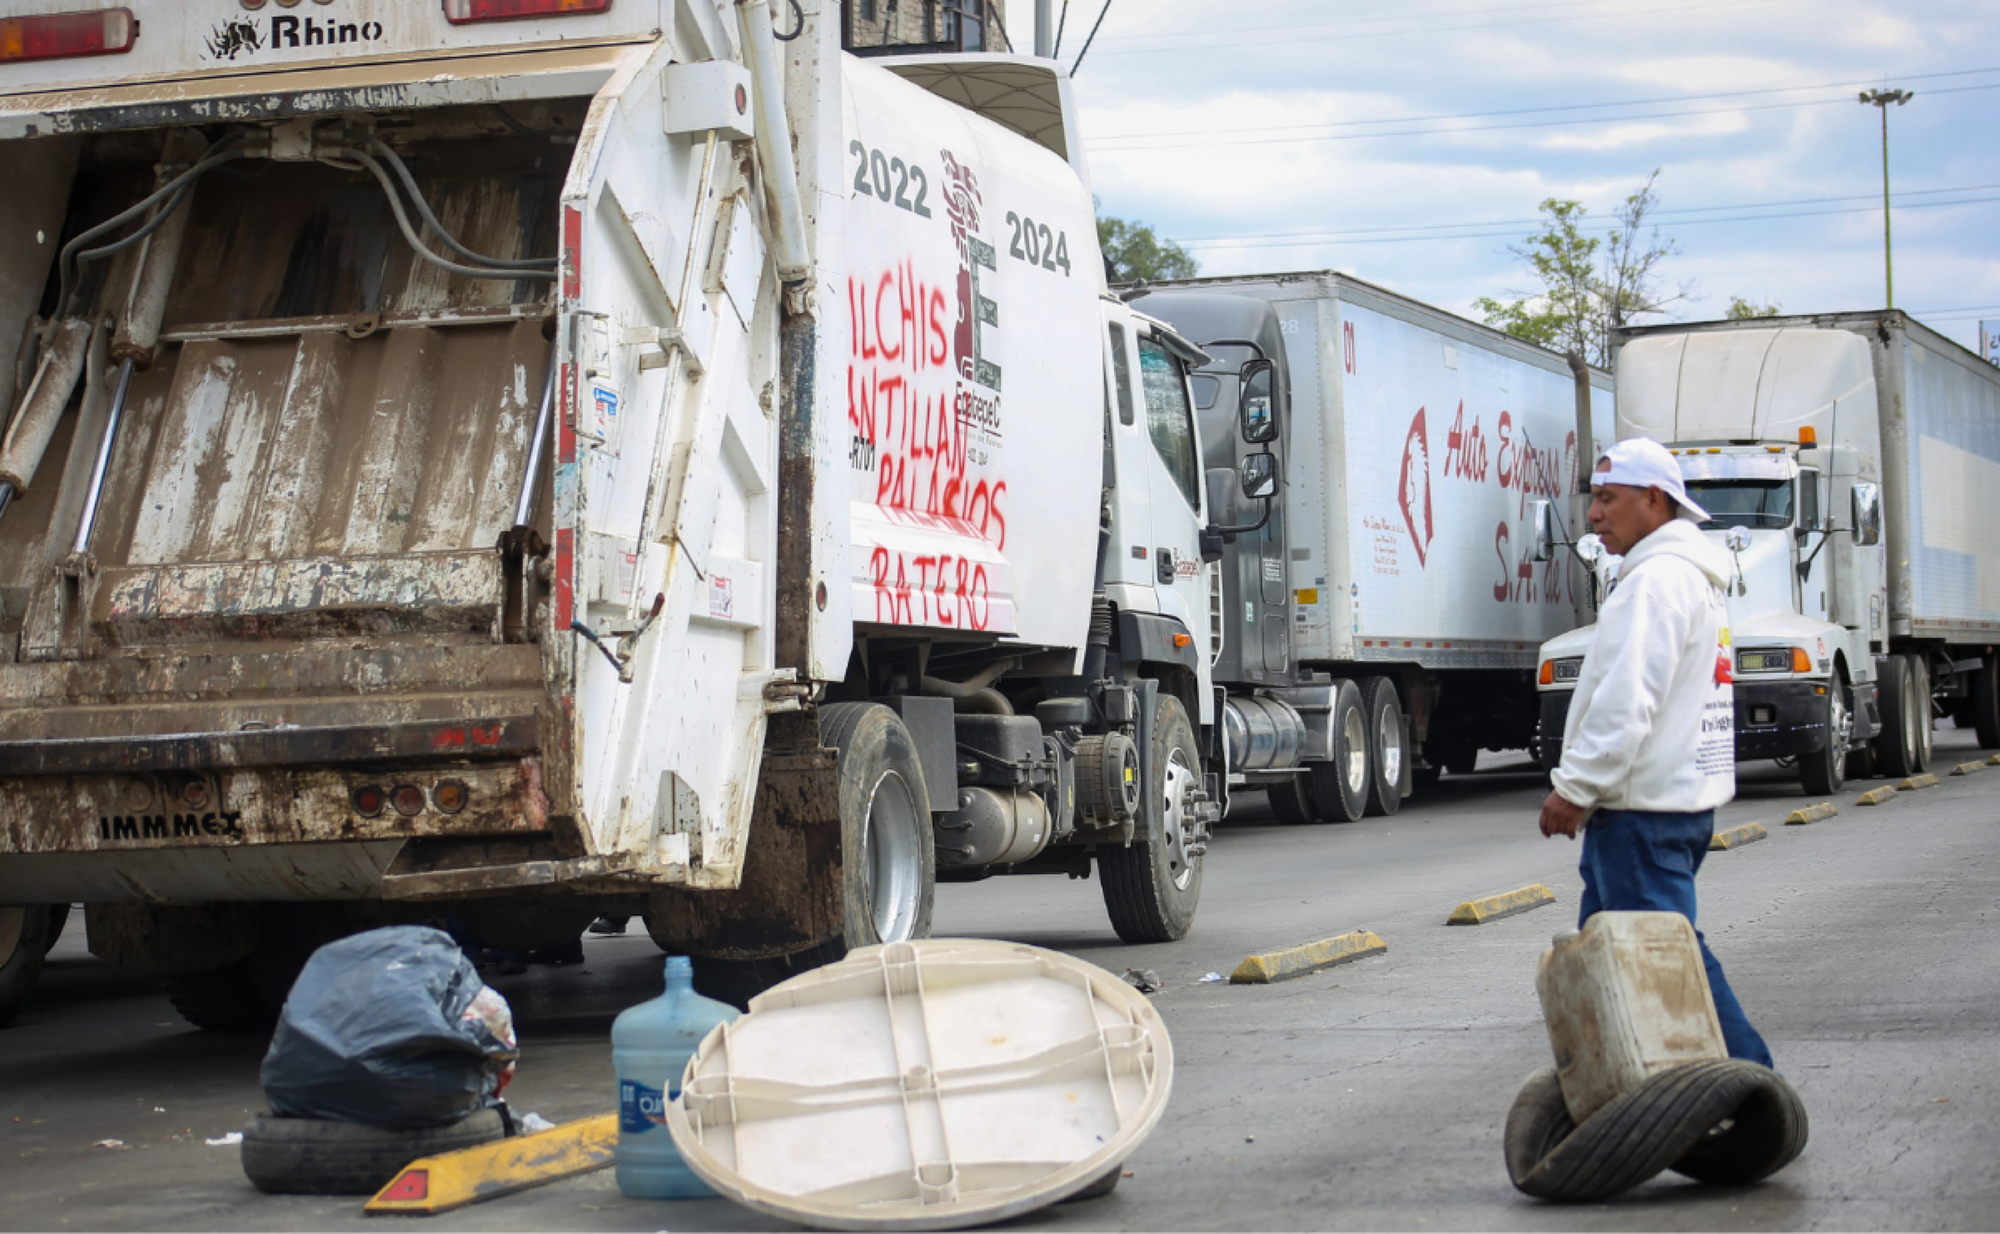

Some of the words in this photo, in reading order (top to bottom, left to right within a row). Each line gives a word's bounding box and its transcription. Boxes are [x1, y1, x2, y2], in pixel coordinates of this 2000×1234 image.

[271, 15, 383, 49] Rhino
[849, 139, 931, 220] 2022
[1006, 210, 1071, 278] 2024
[1443, 398, 1489, 484] Auto
[1497, 410, 1561, 521] Express
[869, 546, 989, 632] RATERO
